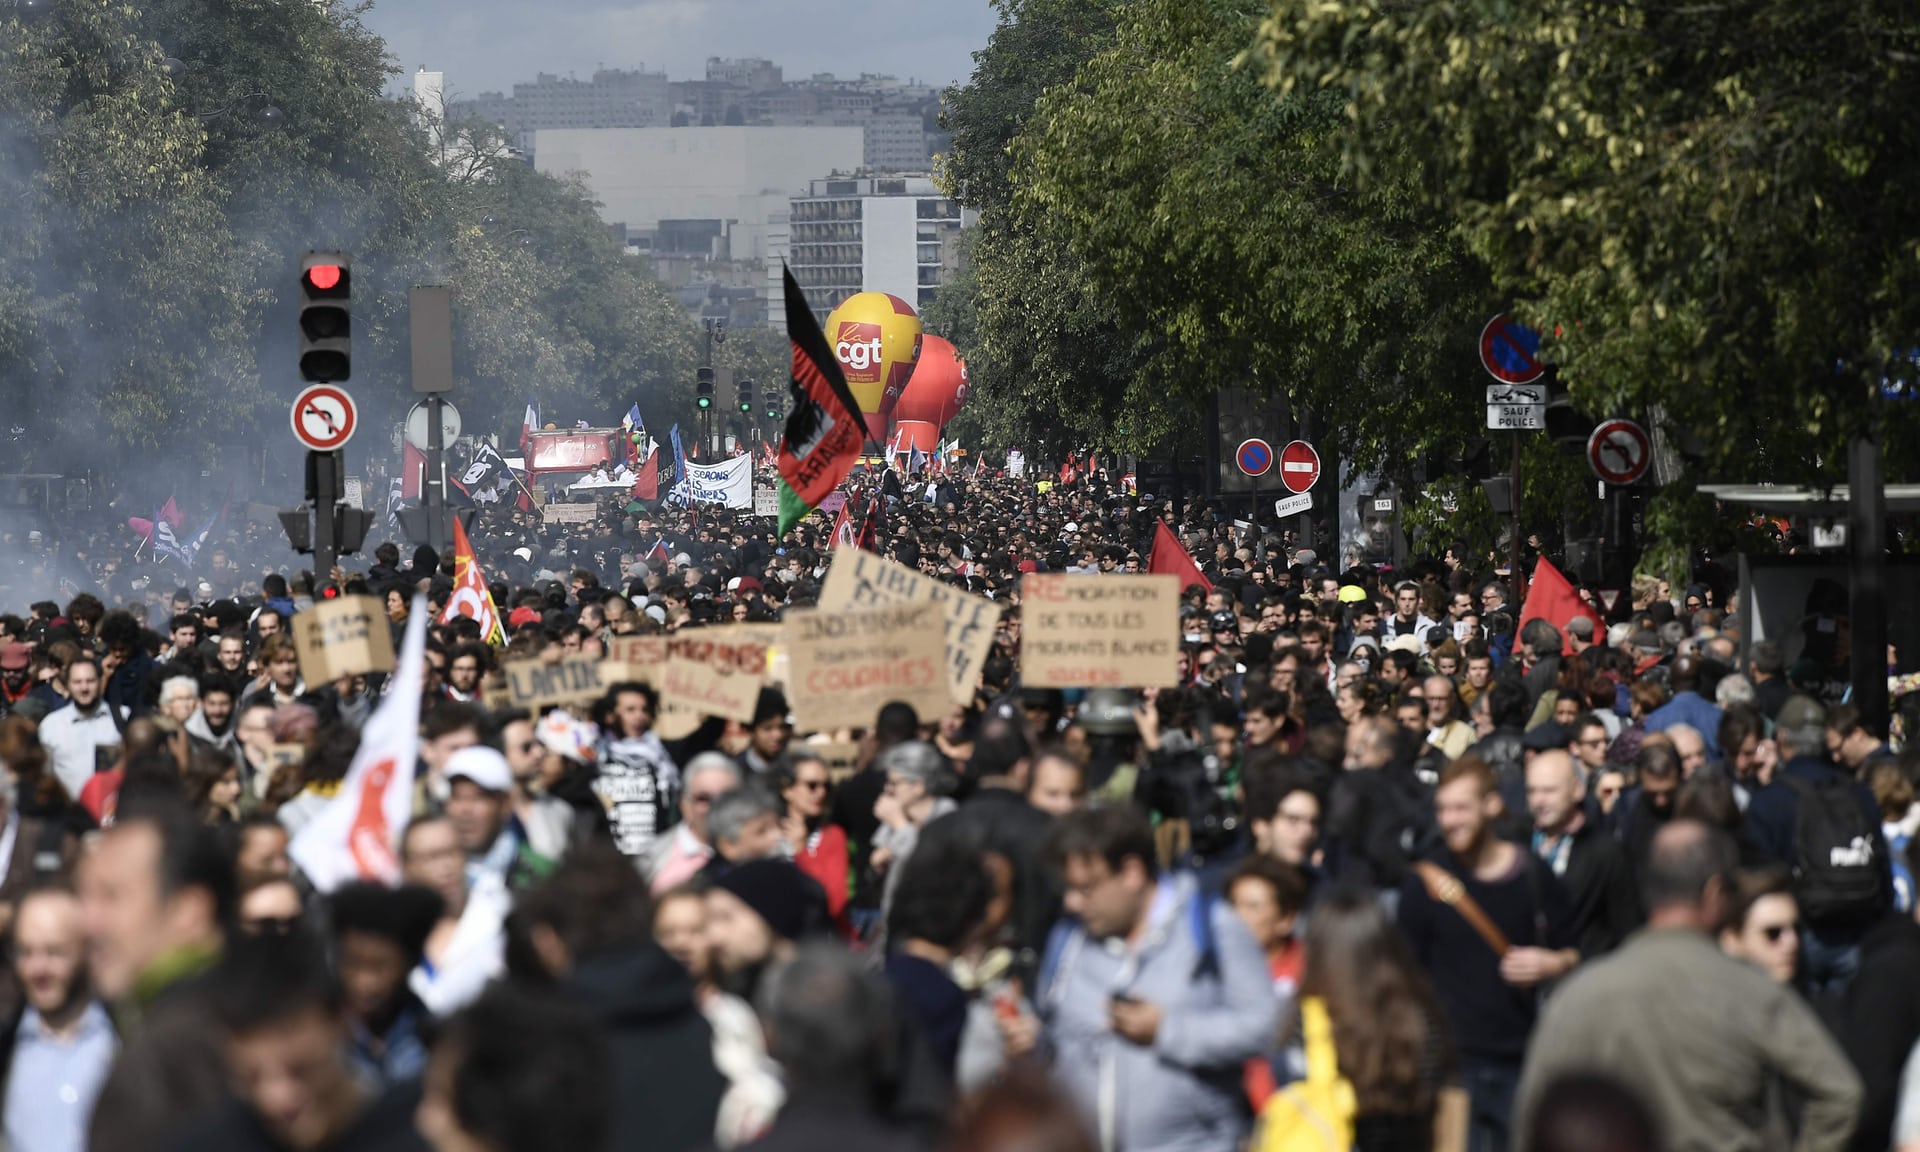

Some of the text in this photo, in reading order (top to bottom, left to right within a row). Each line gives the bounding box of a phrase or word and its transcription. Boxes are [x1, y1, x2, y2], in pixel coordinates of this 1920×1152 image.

[836, 338, 882, 370] cgt
[1503, 407, 1530, 416] SAUF
[1498, 418, 1535, 427] POLICE
[1278, 496, 1310, 512] SAUF POLICE
[1067, 612, 1108, 629] TOUS
[1113, 611, 1145, 629] LES
